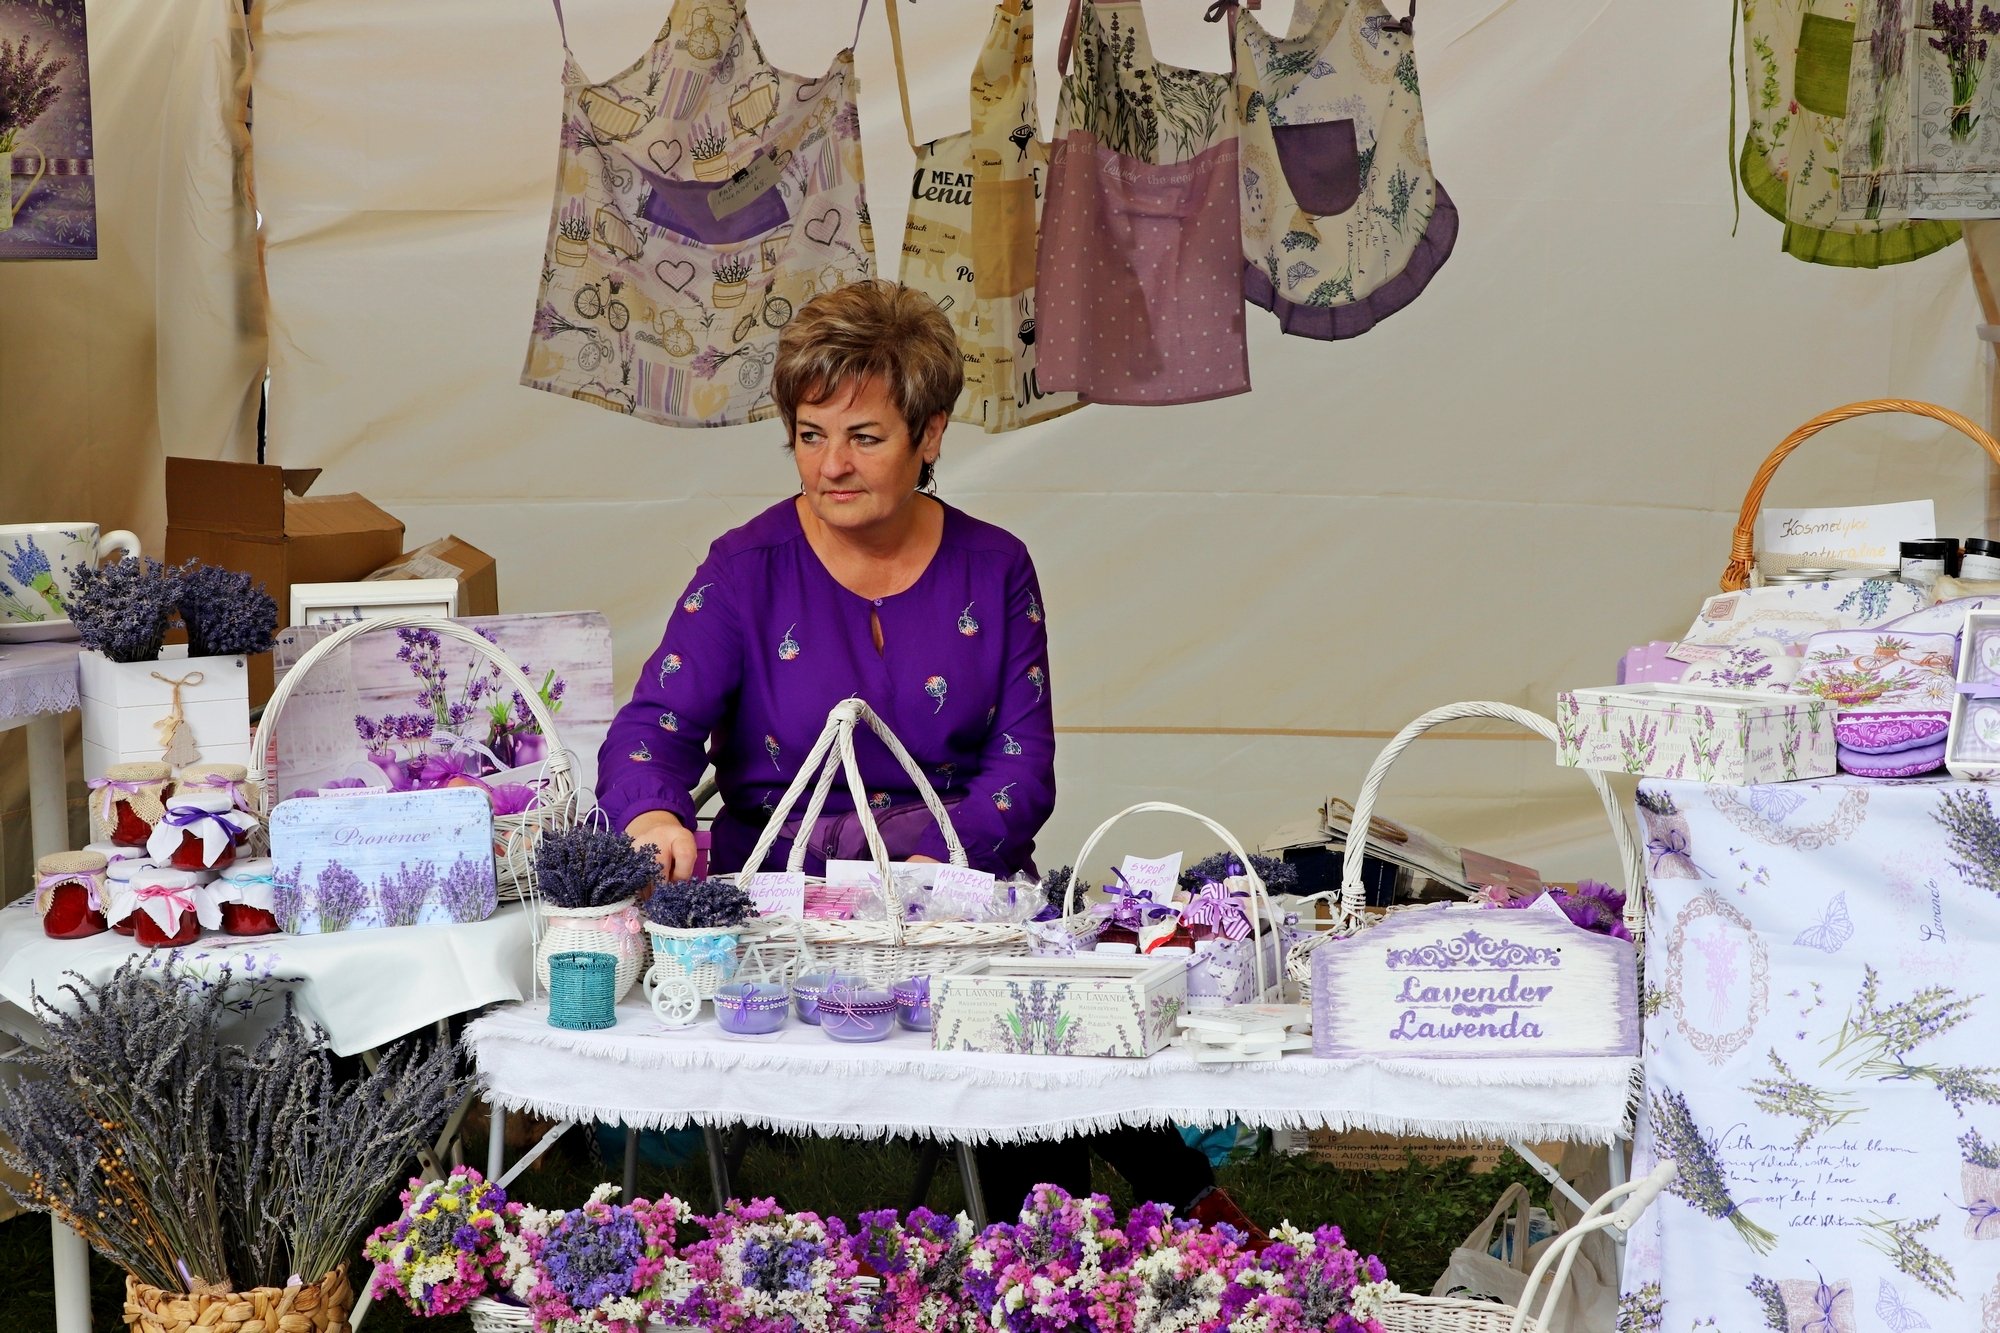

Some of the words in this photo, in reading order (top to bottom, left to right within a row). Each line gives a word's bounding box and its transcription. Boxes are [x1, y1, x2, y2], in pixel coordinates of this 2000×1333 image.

[931, 170, 974, 188] MEAT
[905, 221, 927, 232] Back
[956, 265, 975, 283] Po
[963, 353, 981, 364] Chu
[330, 826, 431, 846] Provence
[1130, 862, 1166, 874] SYROP
[1919, 877, 1947, 945] Lavande
[965, 988, 1007, 999] LAVANDE
[1069, 991, 1083, 1002] LA
[1086, 991, 1128, 1003] LAVANDE
[1394, 973, 1553, 1004] Lavender
[1389, 1010, 1544, 1041] Lawenda
